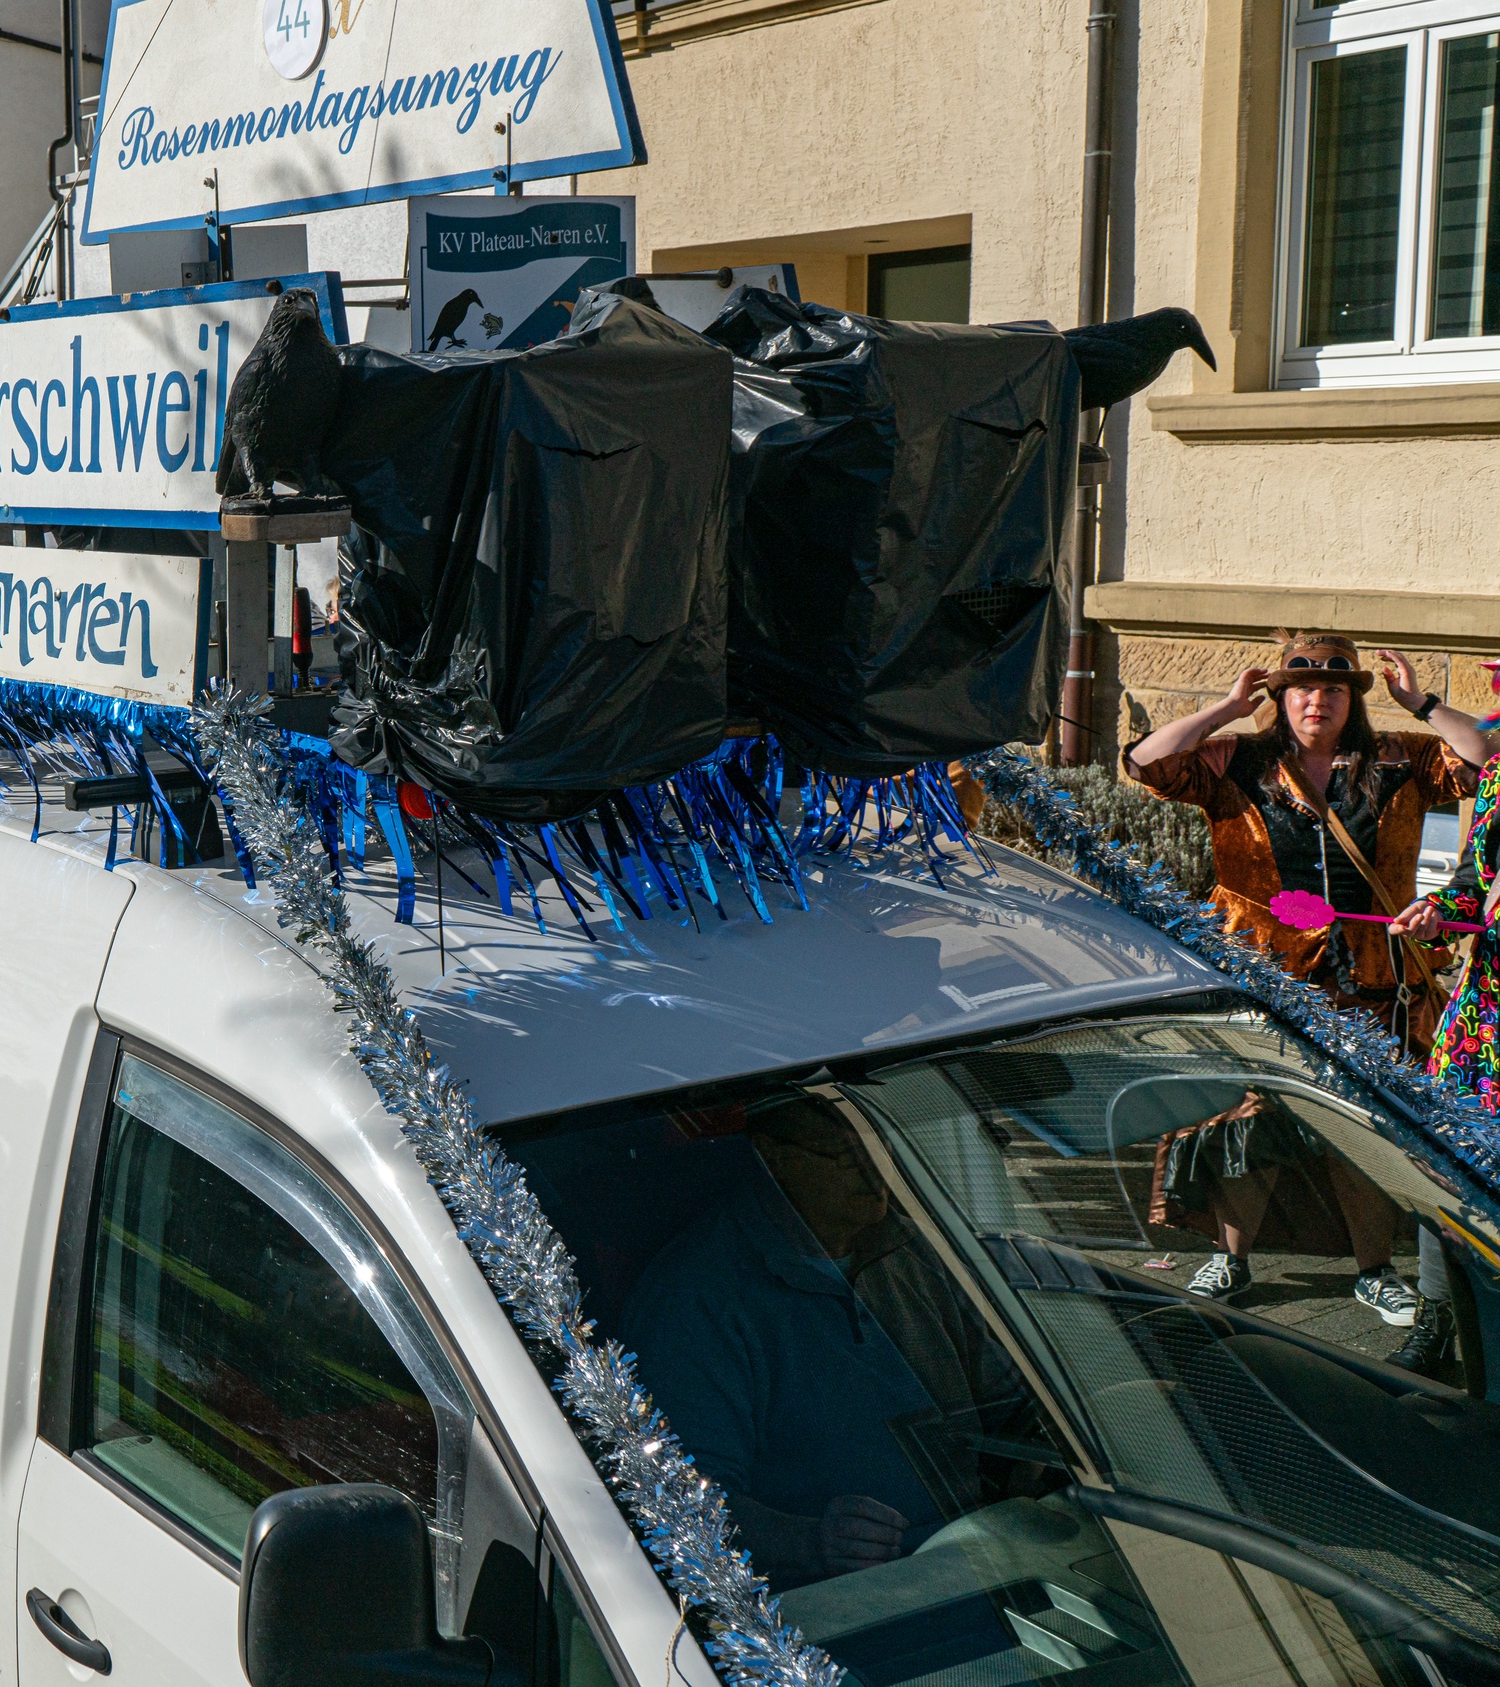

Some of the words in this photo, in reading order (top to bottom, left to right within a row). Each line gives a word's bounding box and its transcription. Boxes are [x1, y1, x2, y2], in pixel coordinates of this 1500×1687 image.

[118, 47, 564, 170] Rosenmontagsumzug
[439, 232, 465, 253] KV
[470, 225, 581, 252] Plateau-Narren
[584, 224, 609, 244] e.V.
